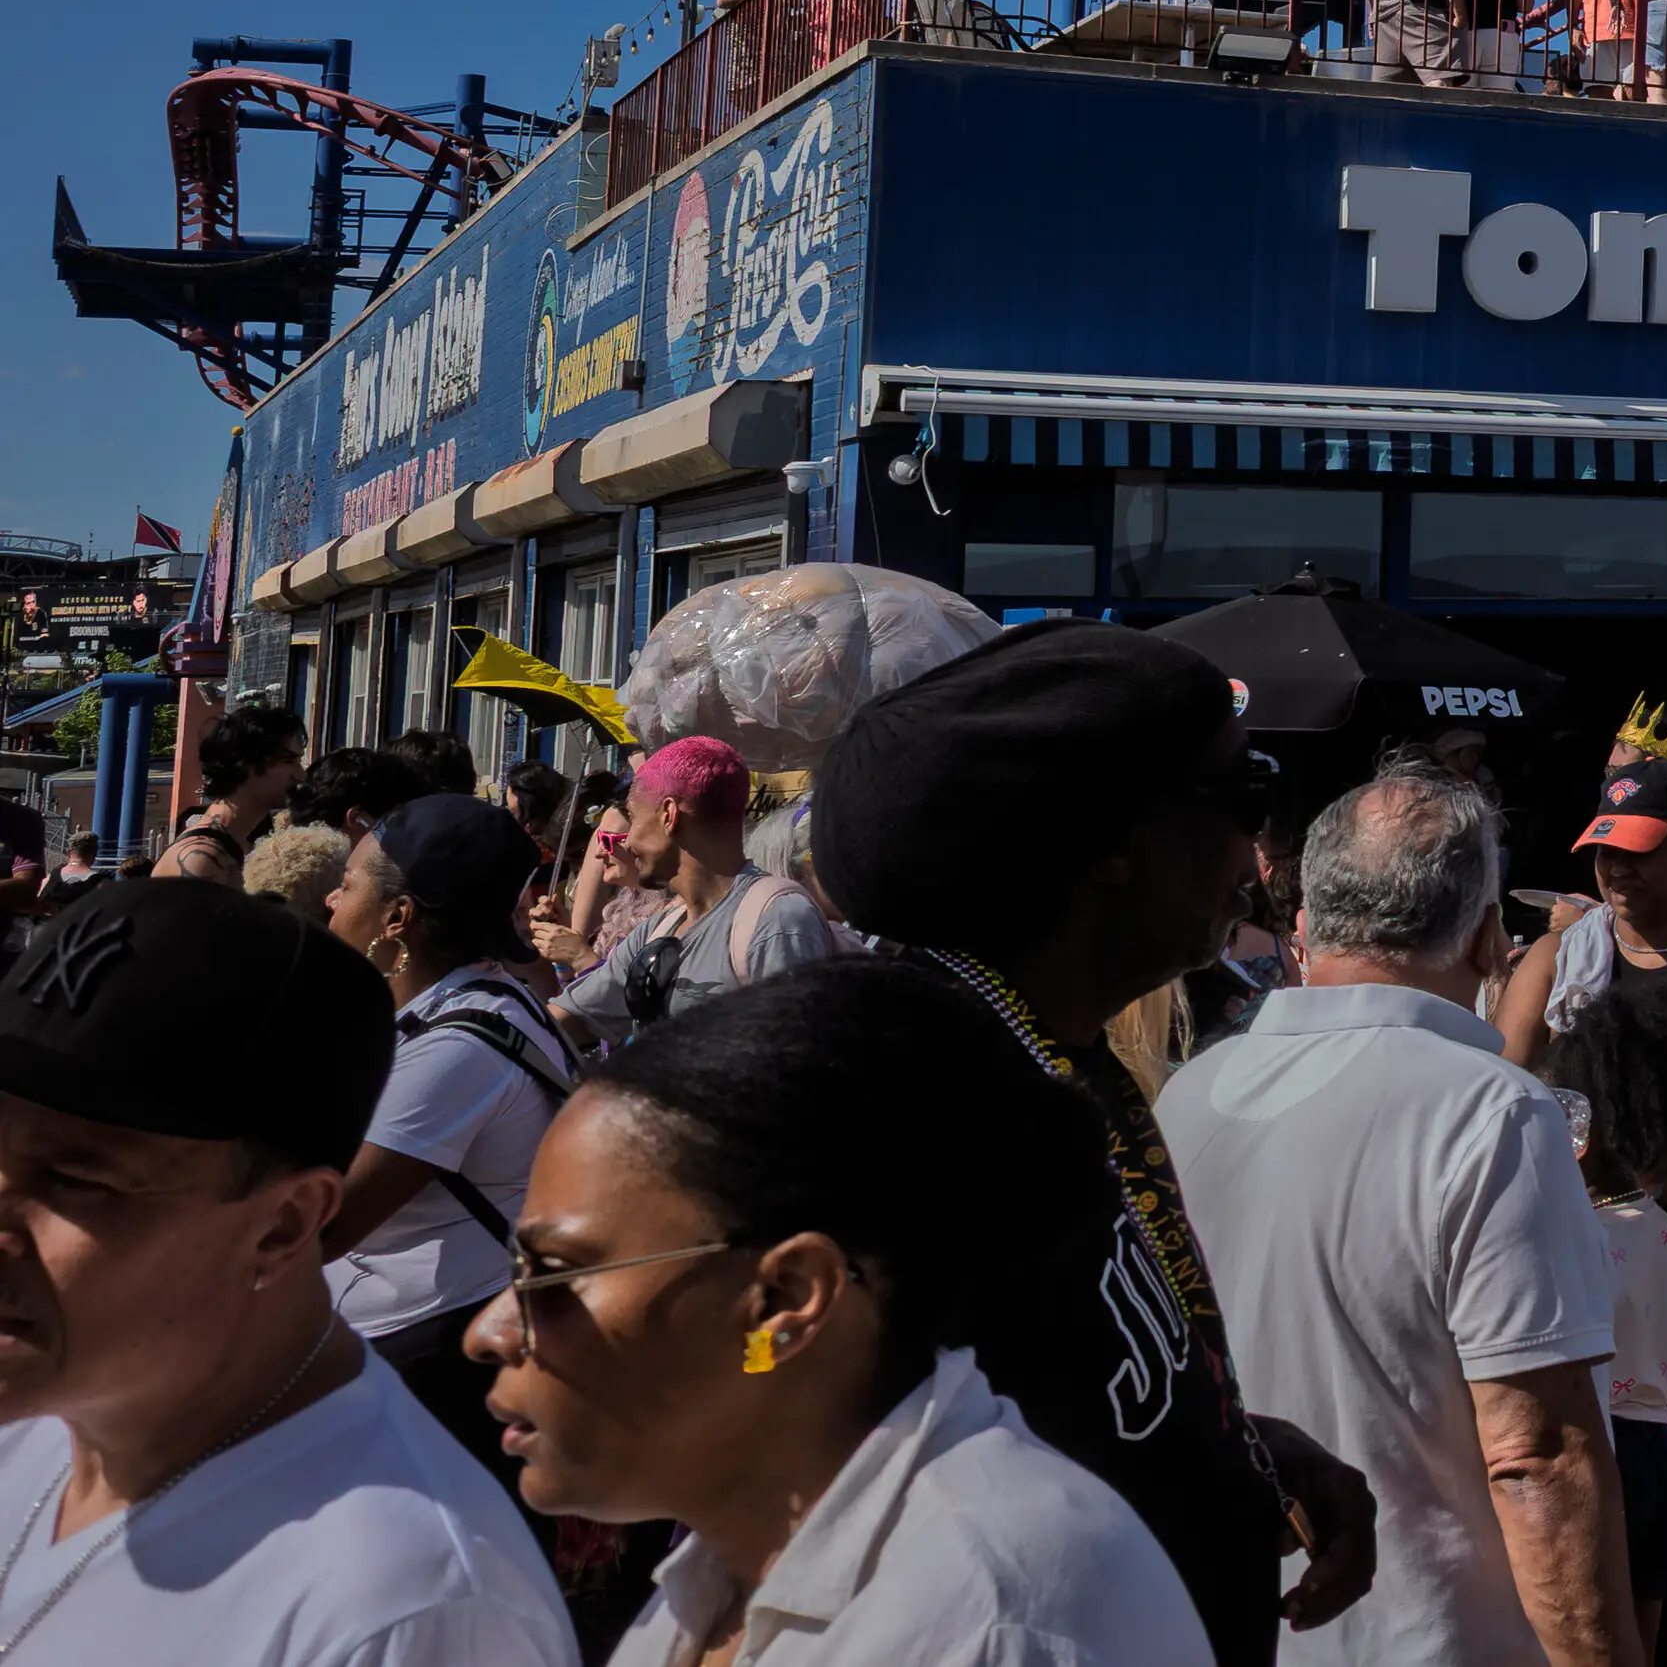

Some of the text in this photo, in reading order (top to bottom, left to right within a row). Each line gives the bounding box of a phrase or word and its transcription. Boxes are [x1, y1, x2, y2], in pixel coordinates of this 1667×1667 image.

[377, 309, 430, 455] Coney
[427, 243, 489, 422] Island
[1420, 686, 1524, 718] PEPSI
